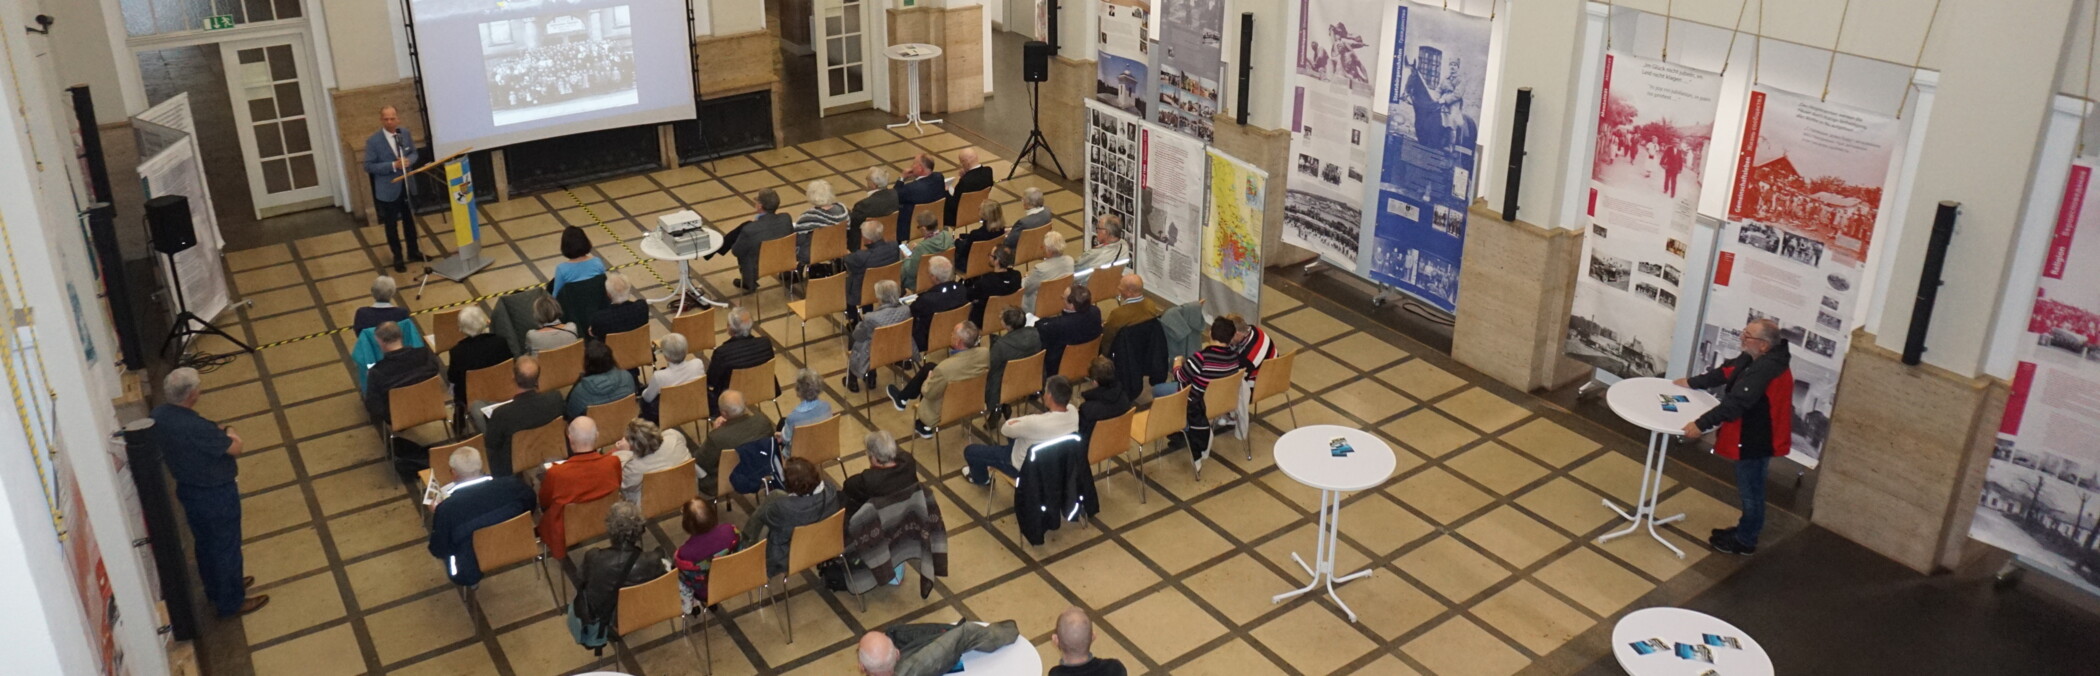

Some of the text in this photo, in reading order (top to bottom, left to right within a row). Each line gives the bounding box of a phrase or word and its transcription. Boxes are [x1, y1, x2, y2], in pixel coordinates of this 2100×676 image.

[1393, 48, 1402, 101] Staatsbürgerschaften
[1752, 95, 1763, 131] сообщества
[1735, 156, 1751, 212] Gemeinschaftsleben
[2050, 246, 2066, 275] Religion
